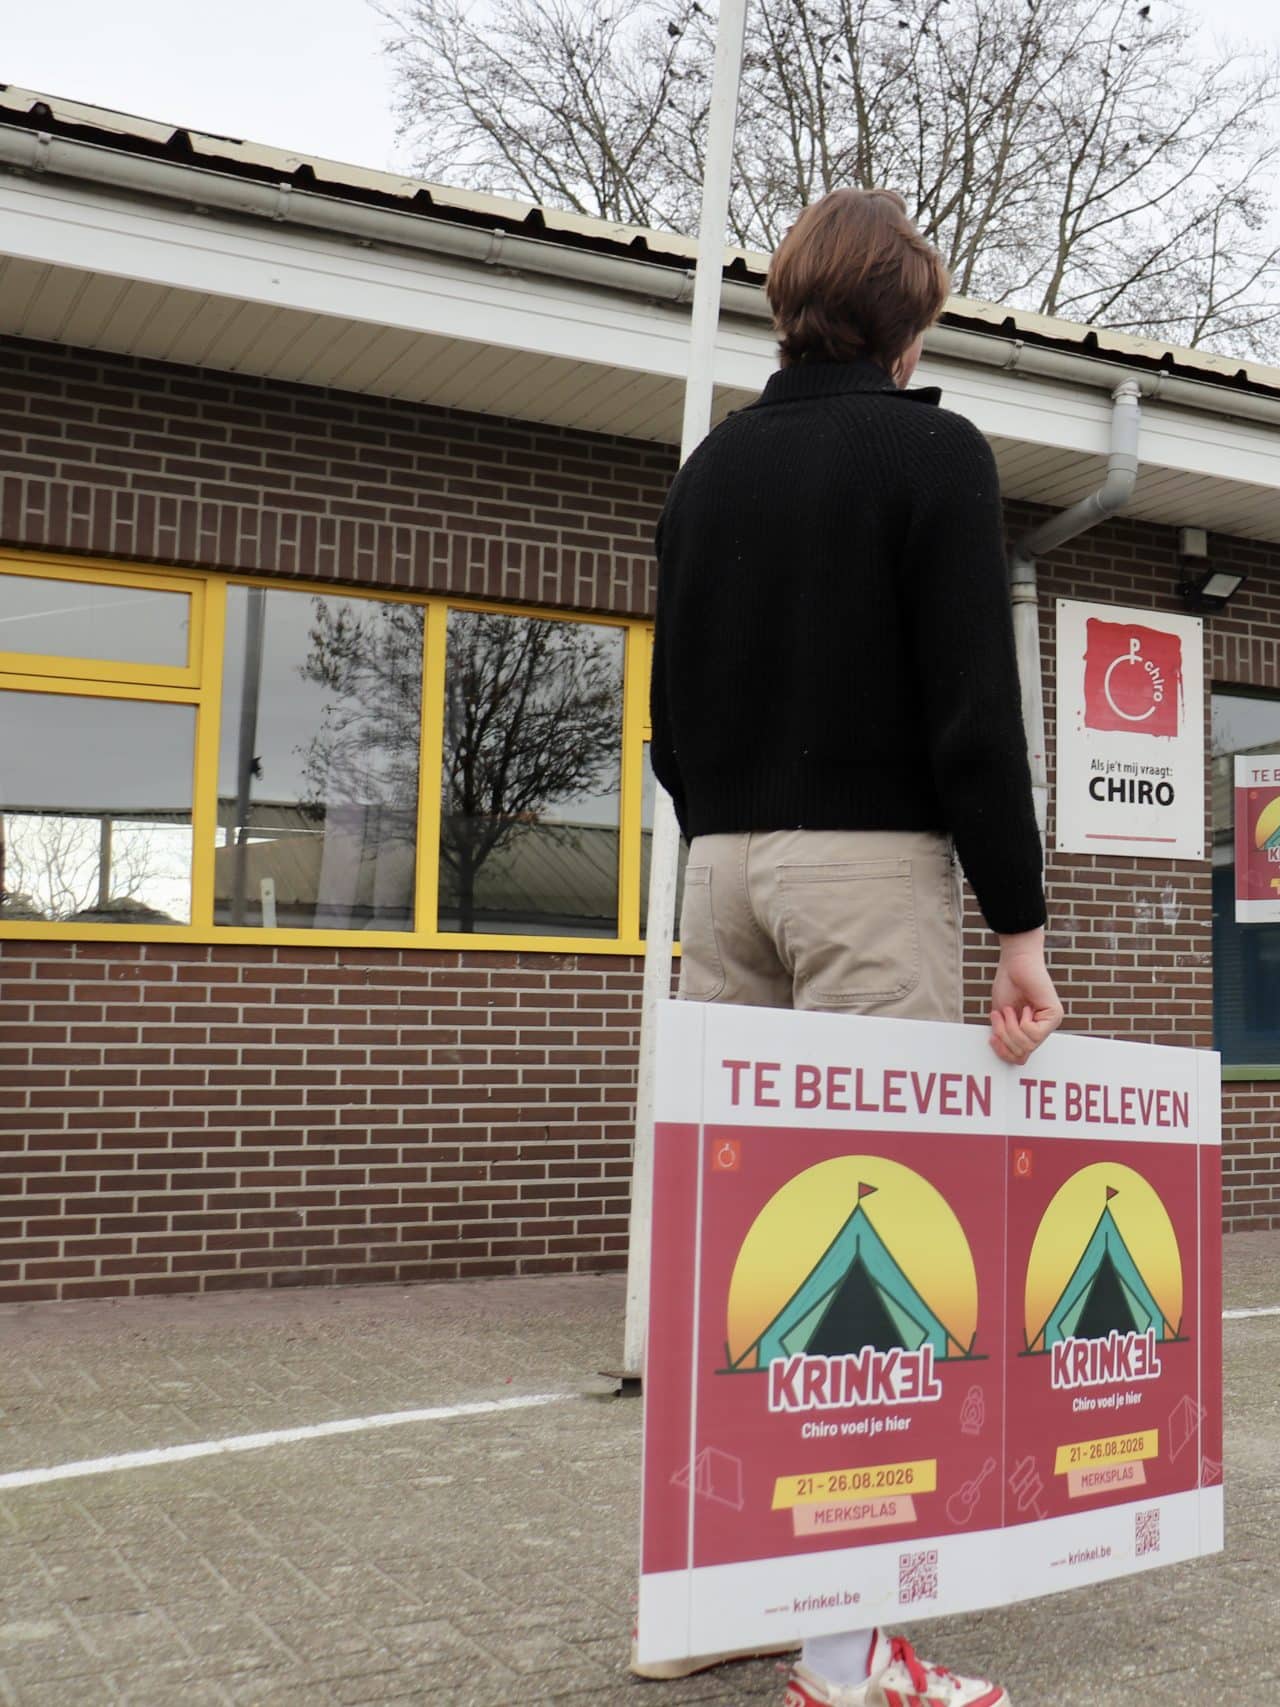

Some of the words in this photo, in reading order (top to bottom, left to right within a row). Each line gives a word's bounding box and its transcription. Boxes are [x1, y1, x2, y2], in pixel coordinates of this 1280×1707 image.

[1144, 661, 1165, 702] chiro
[1091, 759, 1104, 771] Als
[1123, 762, 1138, 776] mij
[1140, 765, 1173, 778] vraagt:
[1252, 769, 1270, 782] TE
[1089, 776, 1175, 806] CHIRO
[722, 1059, 781, 1108] TE
[795, 1064, 992, 1117] BELEVEN
[1019, 1078, 1057, 1122] TE
[1065, 1082, 1189, 1128] BELEVEN
[1052, 1328, 1161, 1389] KRINKEL
[769, 1344, 941, 1411] KRINKEL
[1073, 1397, 1096, 1412] Chiro
[1098, 1393, 1115, 1408] voel
[1115, 1393, 1125, 1410] je
[1125, 1391, 1142, 1404] hier
[801, 1421, 838, 1439] Chiro
[841, 1418, 869, 1435] voel
[869, 1418, 883, 1437] je
[885, 1415, 911, 1431] hier
[1070, 1446, 1081, 1462] 21
[1090, 1437, 1144, 1459] 26.08.2026
[797, 1479, 813, 1496] 21
[828, 1468, 914, 1492] 26.08.2026
[1081, 1467, 1134, 1488] MERKSPLAS
[814, 1502, 897, 1524] MERKSPLAS
[1068, 1545, 1112, 1565] krinkel.be
[793, 1590, 861, 1613] krinkel.be
